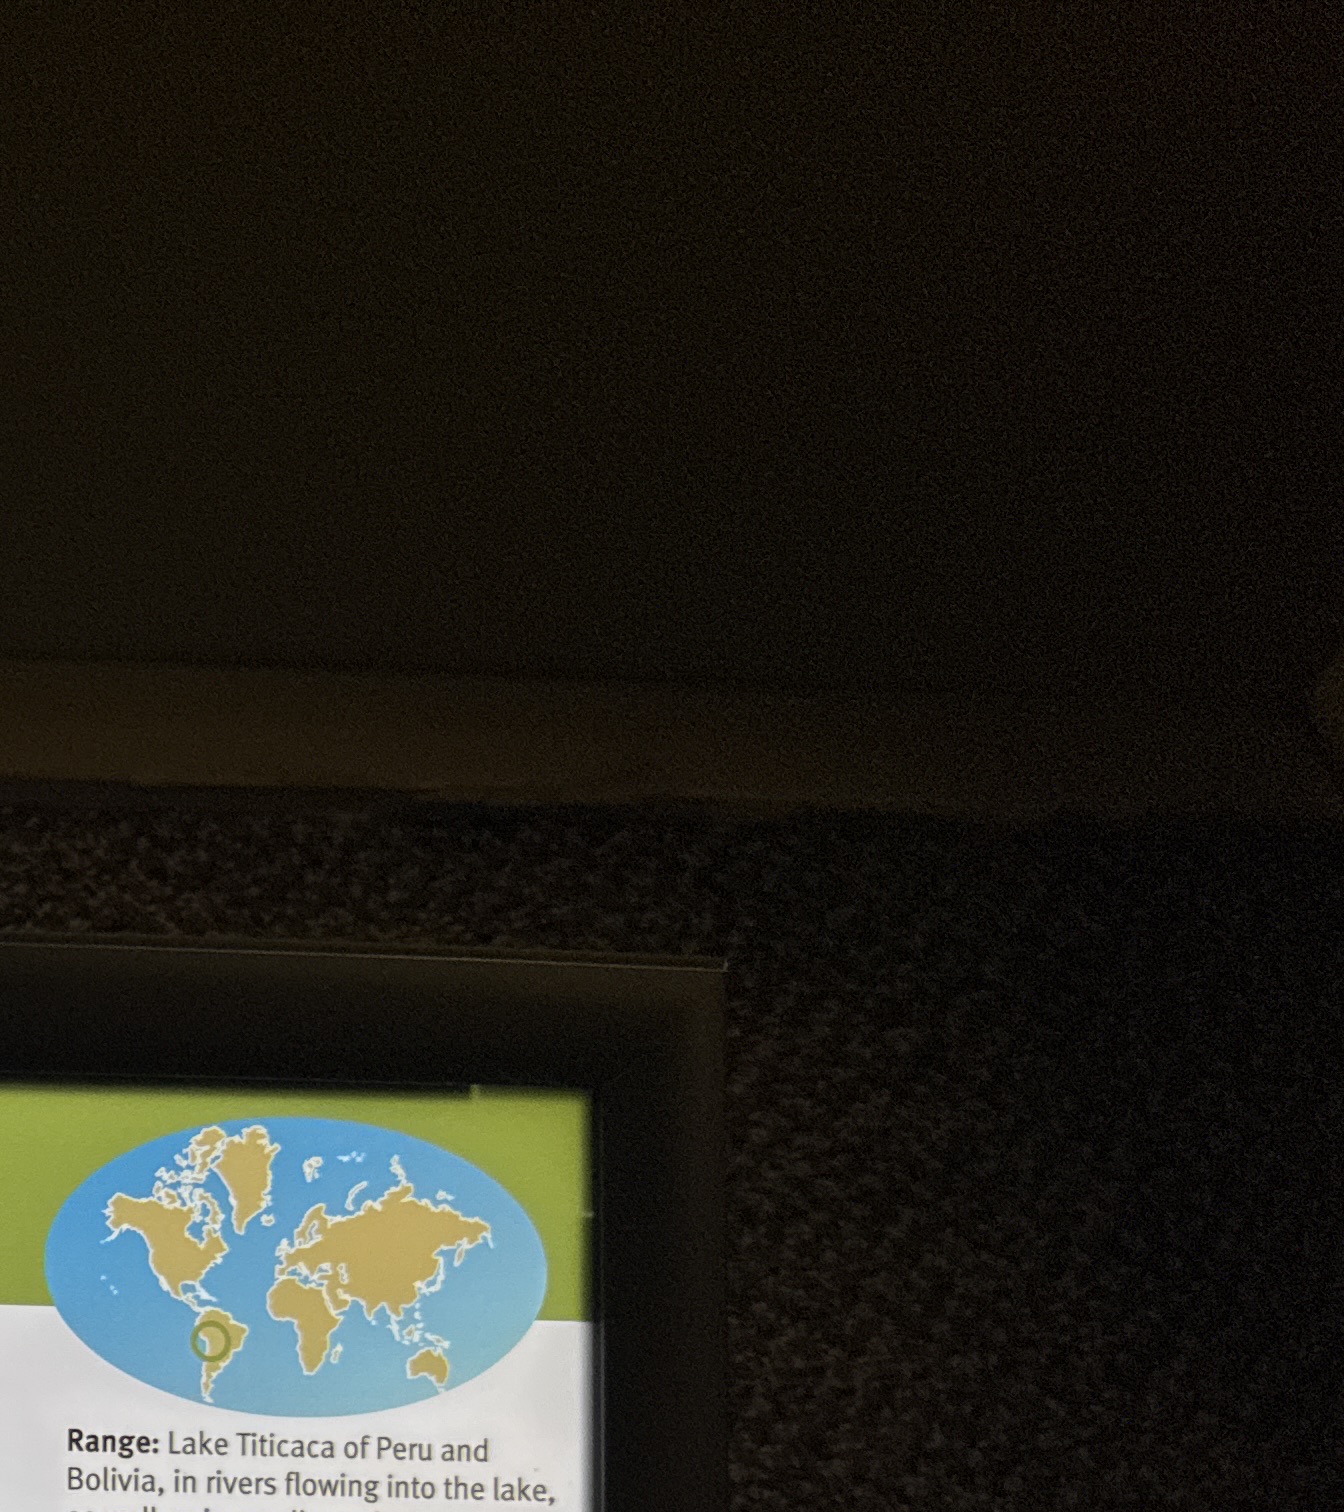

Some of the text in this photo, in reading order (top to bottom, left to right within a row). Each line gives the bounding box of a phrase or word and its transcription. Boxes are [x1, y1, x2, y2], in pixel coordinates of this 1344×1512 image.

[67, 1428, 489, 1463] Range: Lake Titicaca of Peru and
[67, 1466, 556, 1507] Bolivia, in rivers flowing into the lake,
